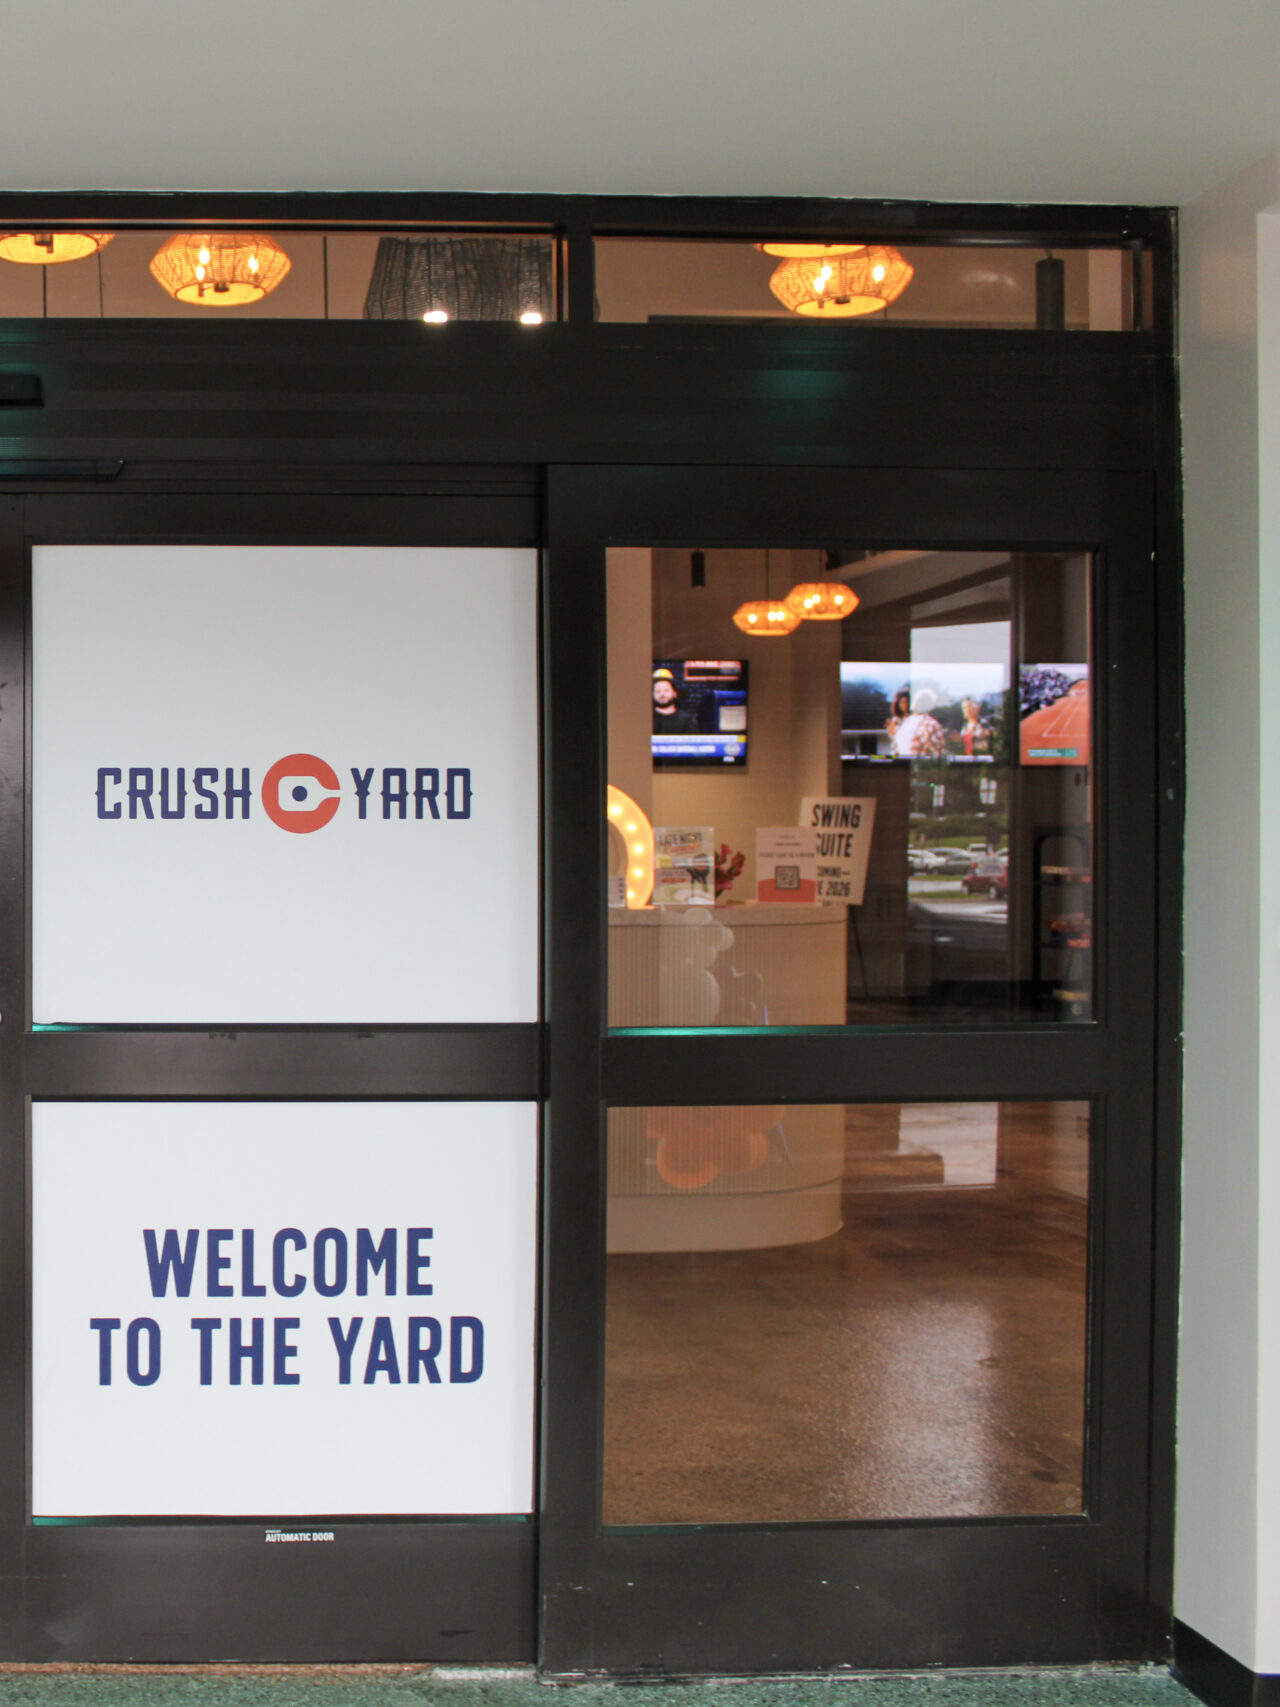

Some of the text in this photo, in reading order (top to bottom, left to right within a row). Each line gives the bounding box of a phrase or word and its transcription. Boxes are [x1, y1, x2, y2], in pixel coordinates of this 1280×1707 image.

[94, 767, 252, 819] CRUSH
[349, 767, 473, 819] YARD
[812, 804, 862, 829] SWING
[142, 1227, 433, 1298] WELCOME
[89, 1315, 484, 1386] TO THE YARD
[265, 1531, 335, 1542] AUTOMATIC DOOR
